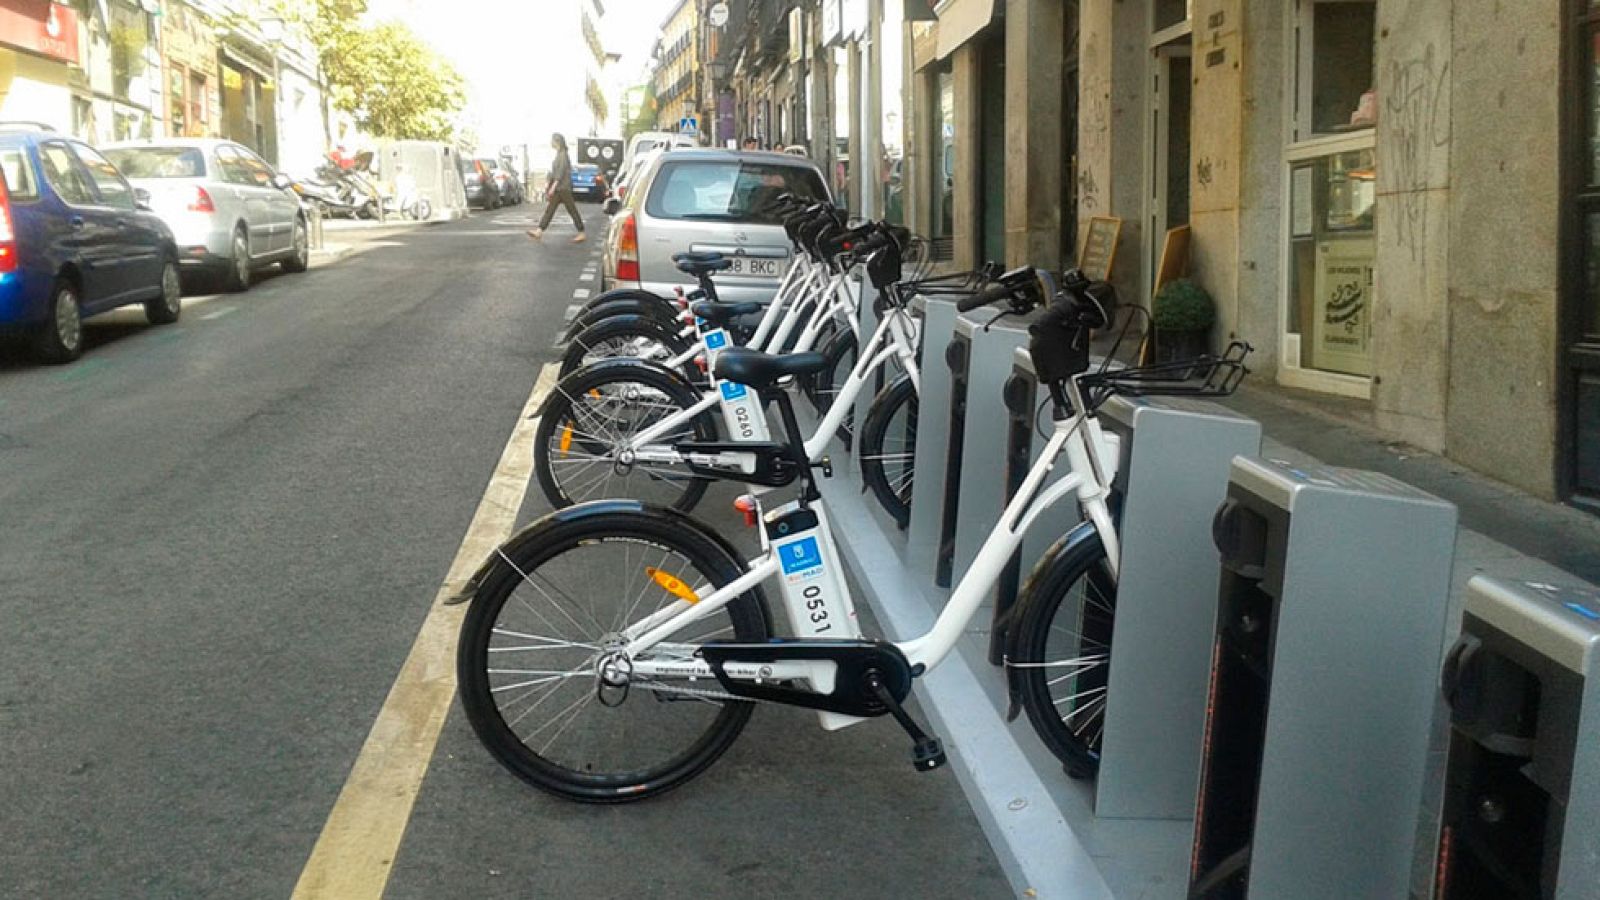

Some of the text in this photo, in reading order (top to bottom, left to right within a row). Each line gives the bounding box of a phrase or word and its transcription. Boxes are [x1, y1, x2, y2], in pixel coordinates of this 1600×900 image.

[750, 260, 775, 274] BKC
[736, 407, 753, 438] 0260
[803, 586, 832, 633] 0531
